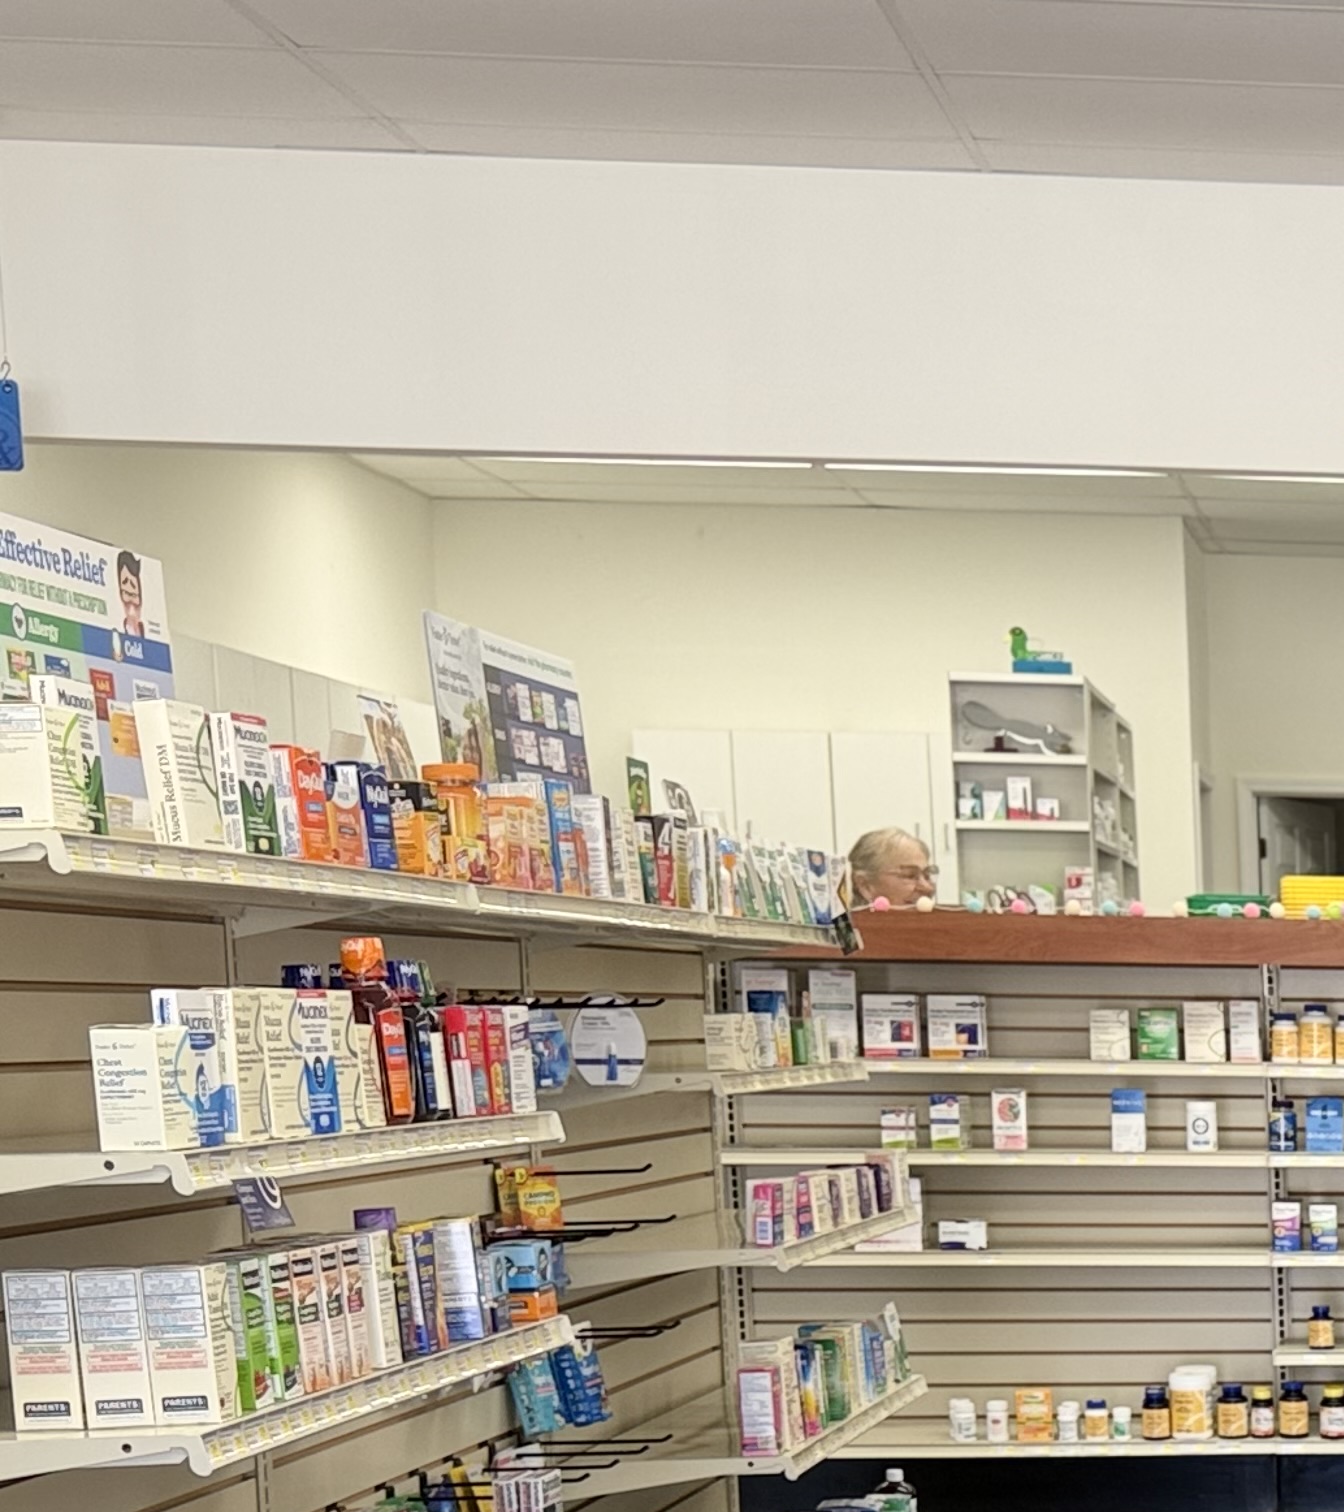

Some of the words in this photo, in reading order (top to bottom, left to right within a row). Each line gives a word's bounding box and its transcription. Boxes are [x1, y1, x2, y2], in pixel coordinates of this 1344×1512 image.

[61, 547, 107, 586] Relief
[28, 616, 60, 643] Allergy
[124, 639, 144, 659] Cold
[97, 1058, 122, 1067] Chest
[98, 1068, 148, 1079] Congestion
[100, 1079, 125, 1088] Relief
